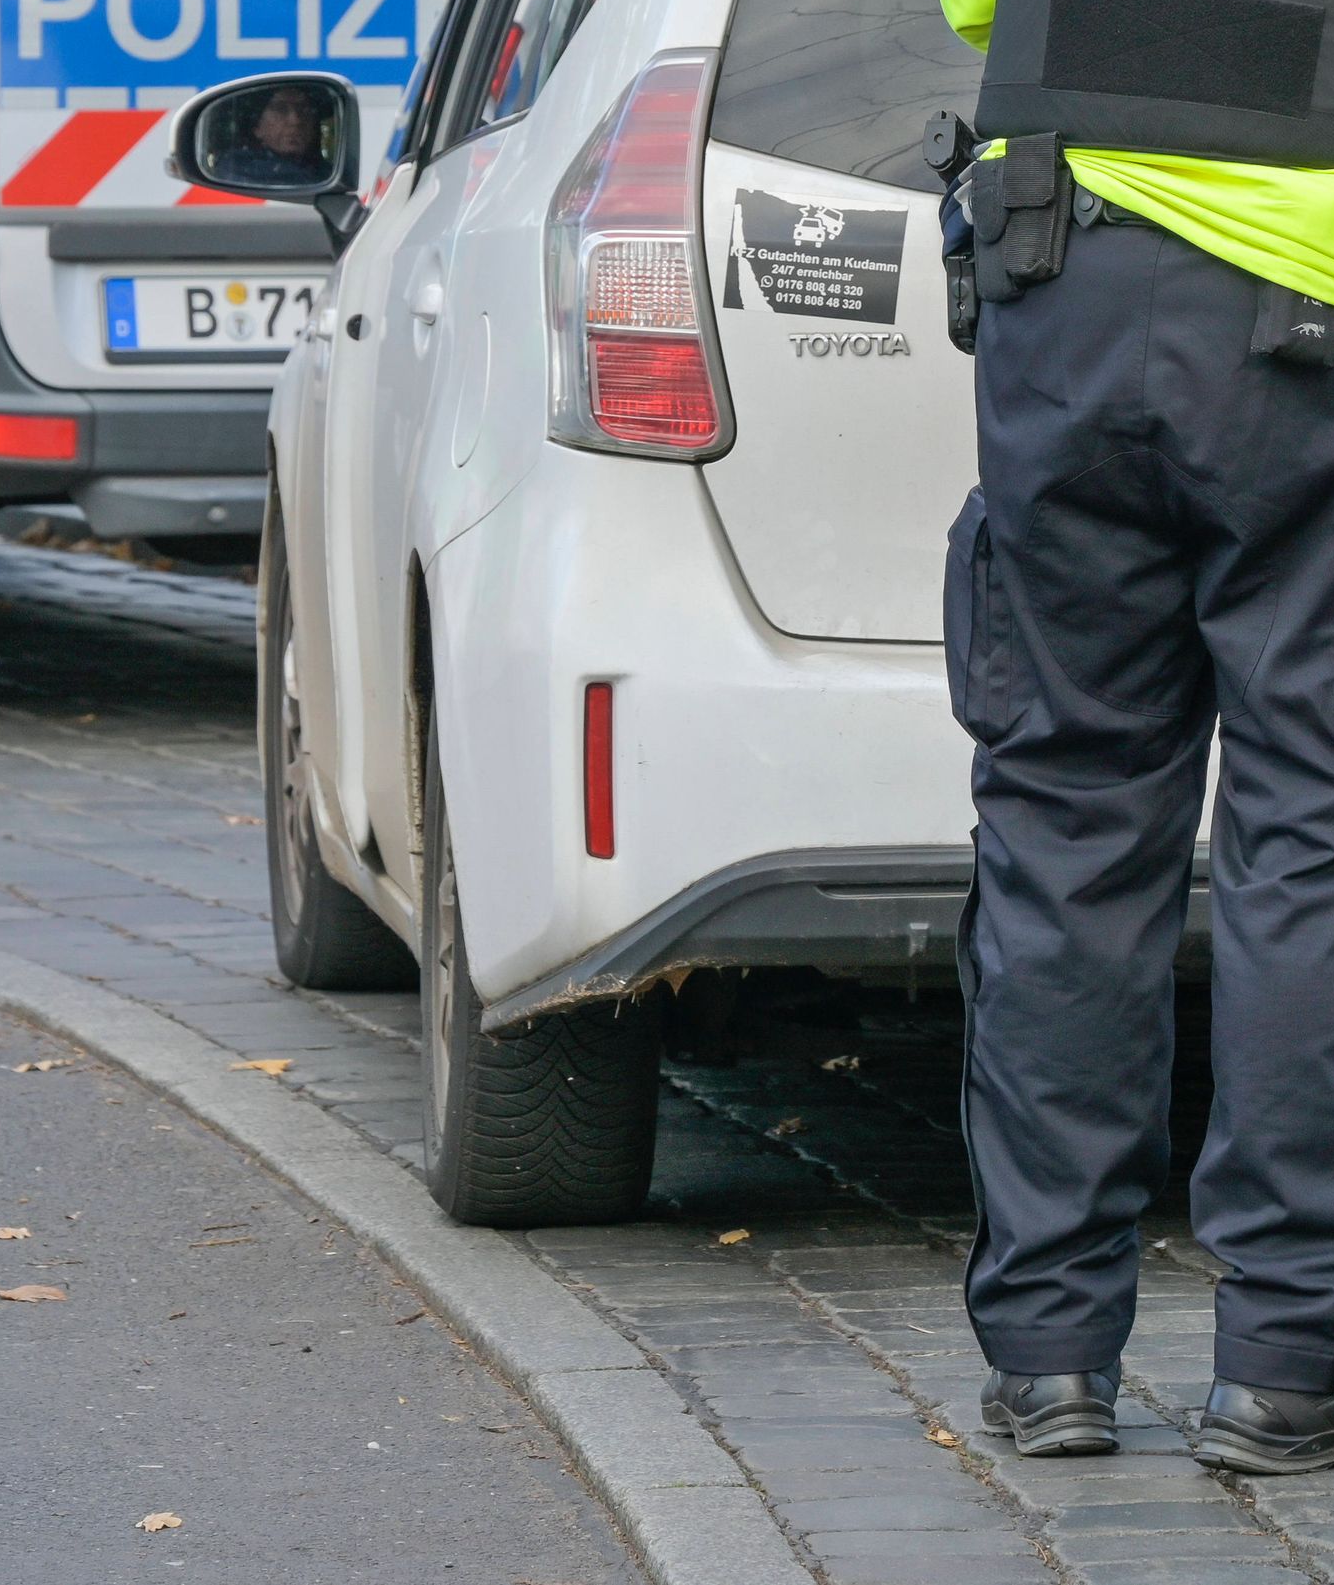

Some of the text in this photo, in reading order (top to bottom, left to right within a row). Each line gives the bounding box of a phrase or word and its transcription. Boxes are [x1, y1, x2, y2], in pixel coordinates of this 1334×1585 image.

[758, 249, 820, 264] Gutachten
[822, 258, 841, 267] am
[844, 257, 898, 272] Kudamm
[771, 264, 854, 281] 24/7 erreichbar
[777, 278, 863, 296] 0176 808 48 320
[775, 292, 862, 310] 0176 808 48 320
[186, 287, 217, 339] B
[789, 332, 910, 357] TOYOTA
